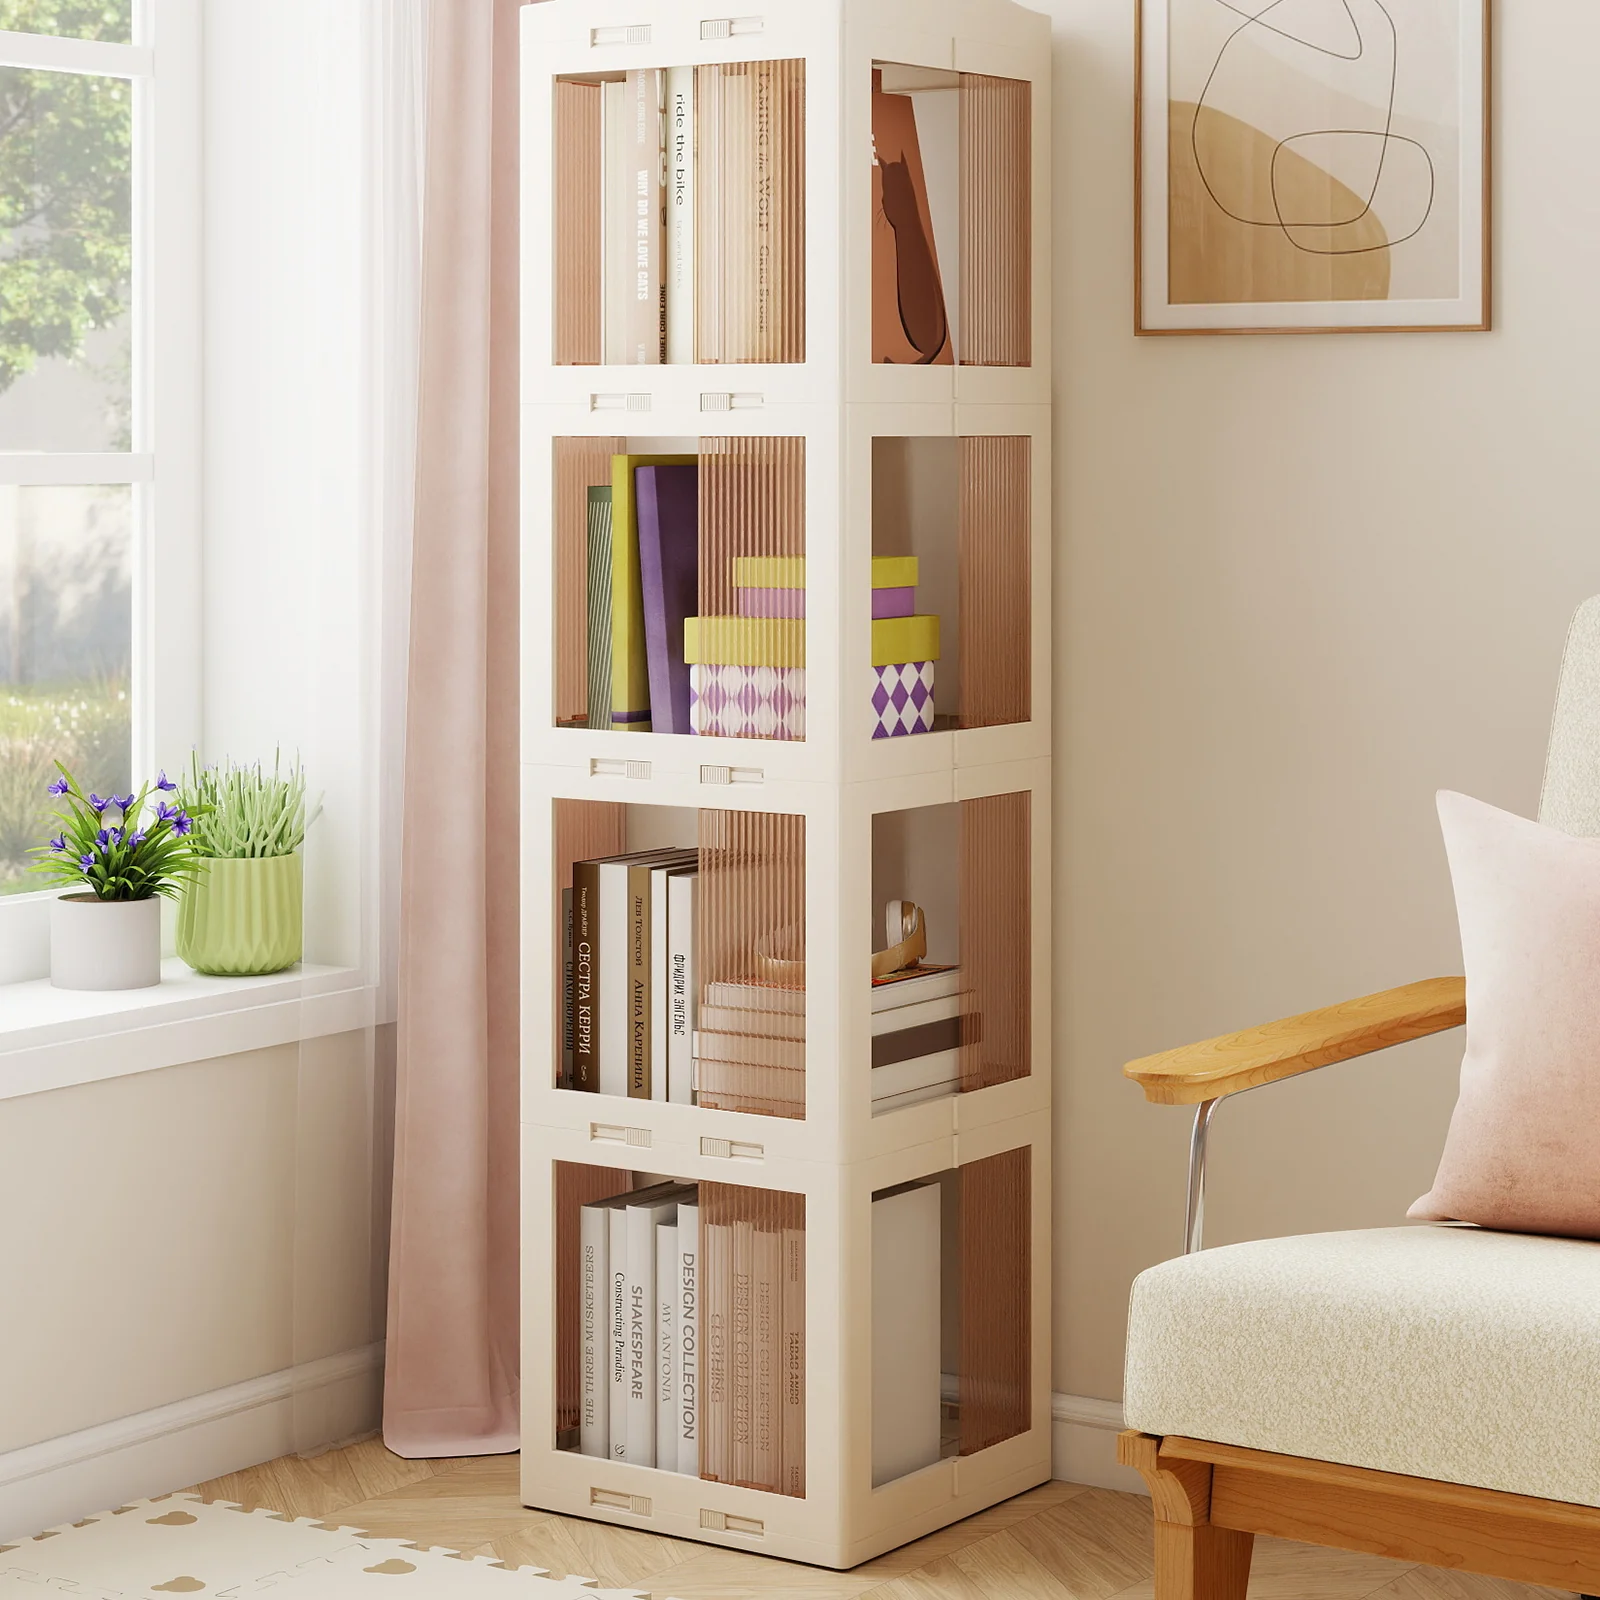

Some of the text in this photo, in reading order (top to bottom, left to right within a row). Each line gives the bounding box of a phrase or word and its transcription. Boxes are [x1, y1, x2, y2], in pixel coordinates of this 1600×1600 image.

[675, 94, 685, 206] ride the bike
[637, 170, 648, 300] WHY DO WE LOVE CATS
[565, 961, 573, 1051] СТИХОТВОРЕНИЯ
[578, 942, 591, 1055] СЕСТРА КЕРРИ
[673, 954, 686, 1036] ФРИДРИХ ЭНГЕЛЬС
[585, 1245, 594, 1428] THE THREE MUSKETEERS
[613, 1272, 625, 1383] Constructing Paradies
[631, 1285, 643, 1400] SHAKESPEARE
[662, 1302, 671, 1402] MY ANTONIA
[683, 1252, 695, 1440] DESIGN COLLECTION
[711, 1313, 724, 1403] CLOTHING
